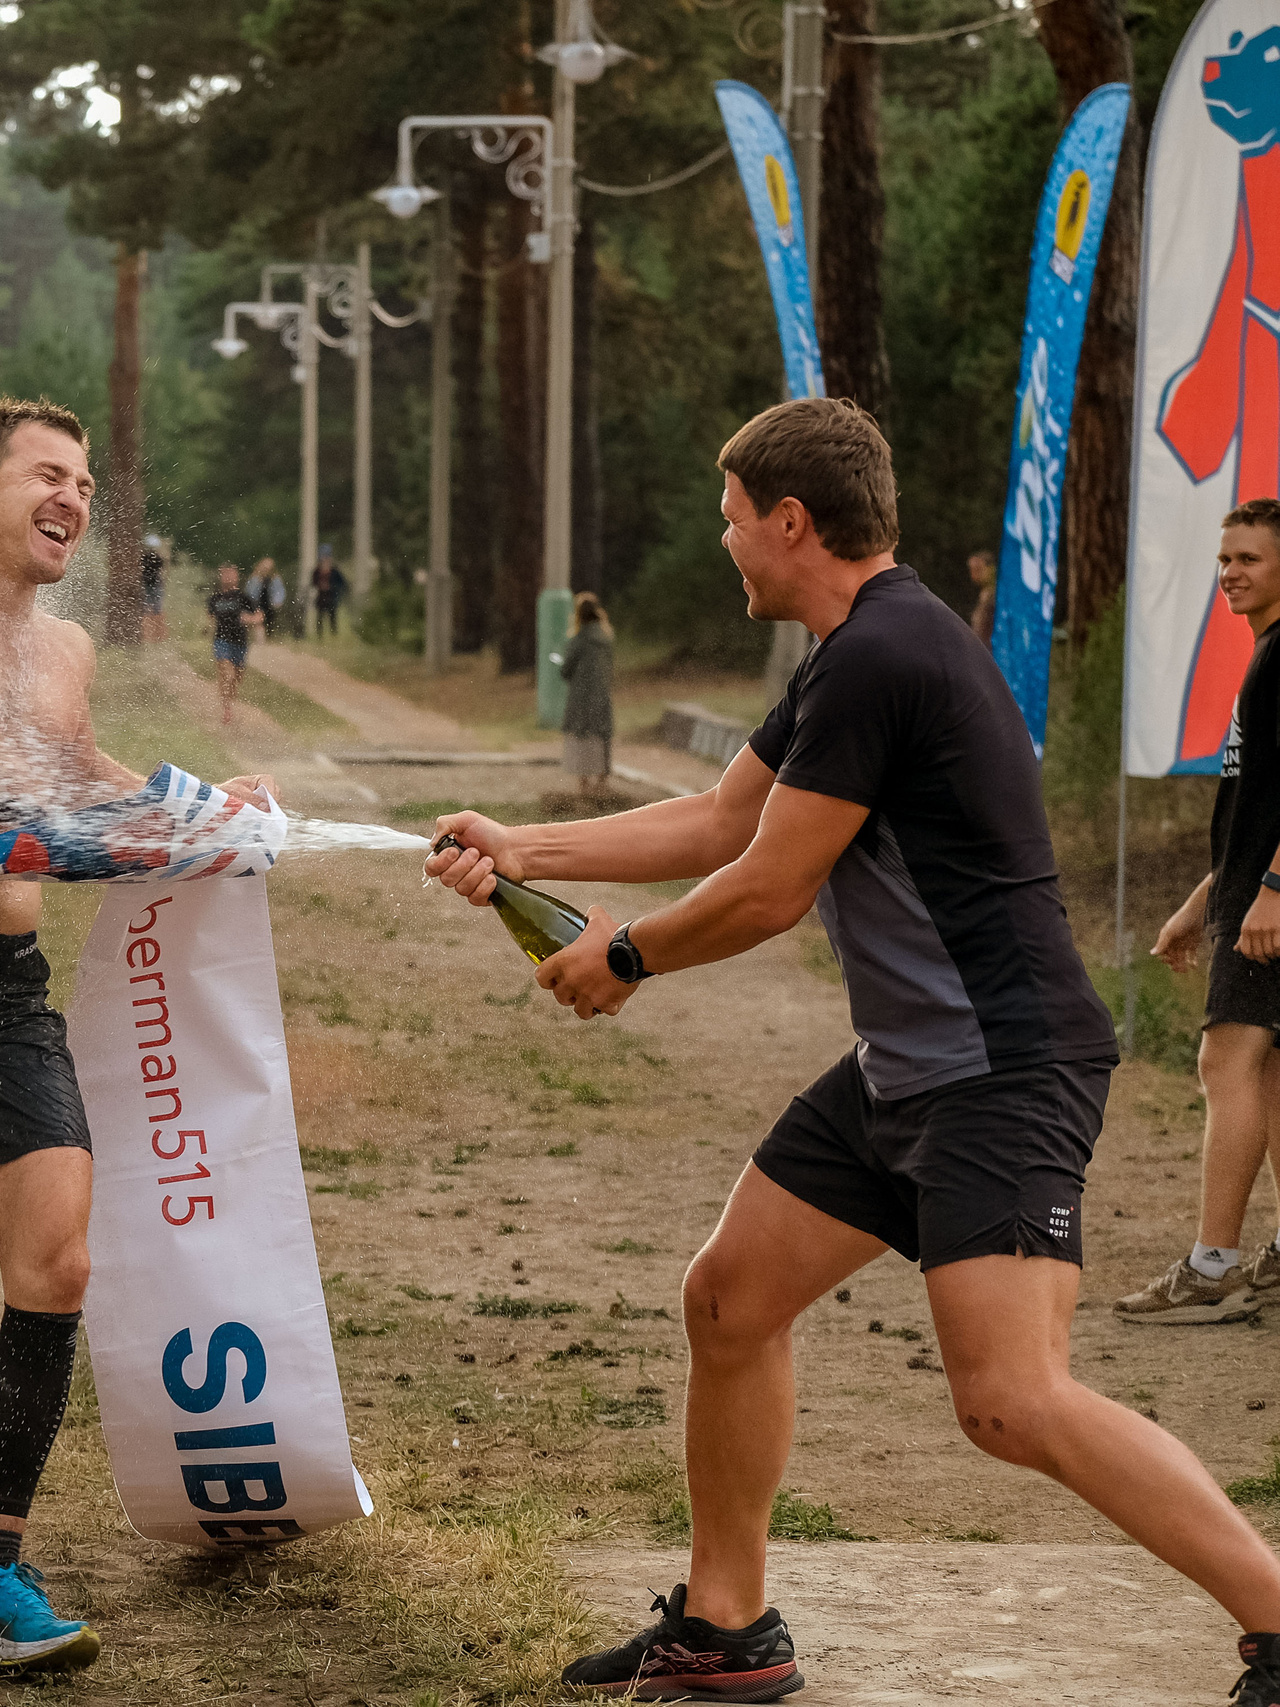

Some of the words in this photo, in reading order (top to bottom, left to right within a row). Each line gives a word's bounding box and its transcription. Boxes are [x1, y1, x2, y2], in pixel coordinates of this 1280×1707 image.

[1051, 1206, 1070, 1216] COMP
[1049, 1217, 1069, 1228] RESS
[161, 1321, 308, 1545] SIBE
